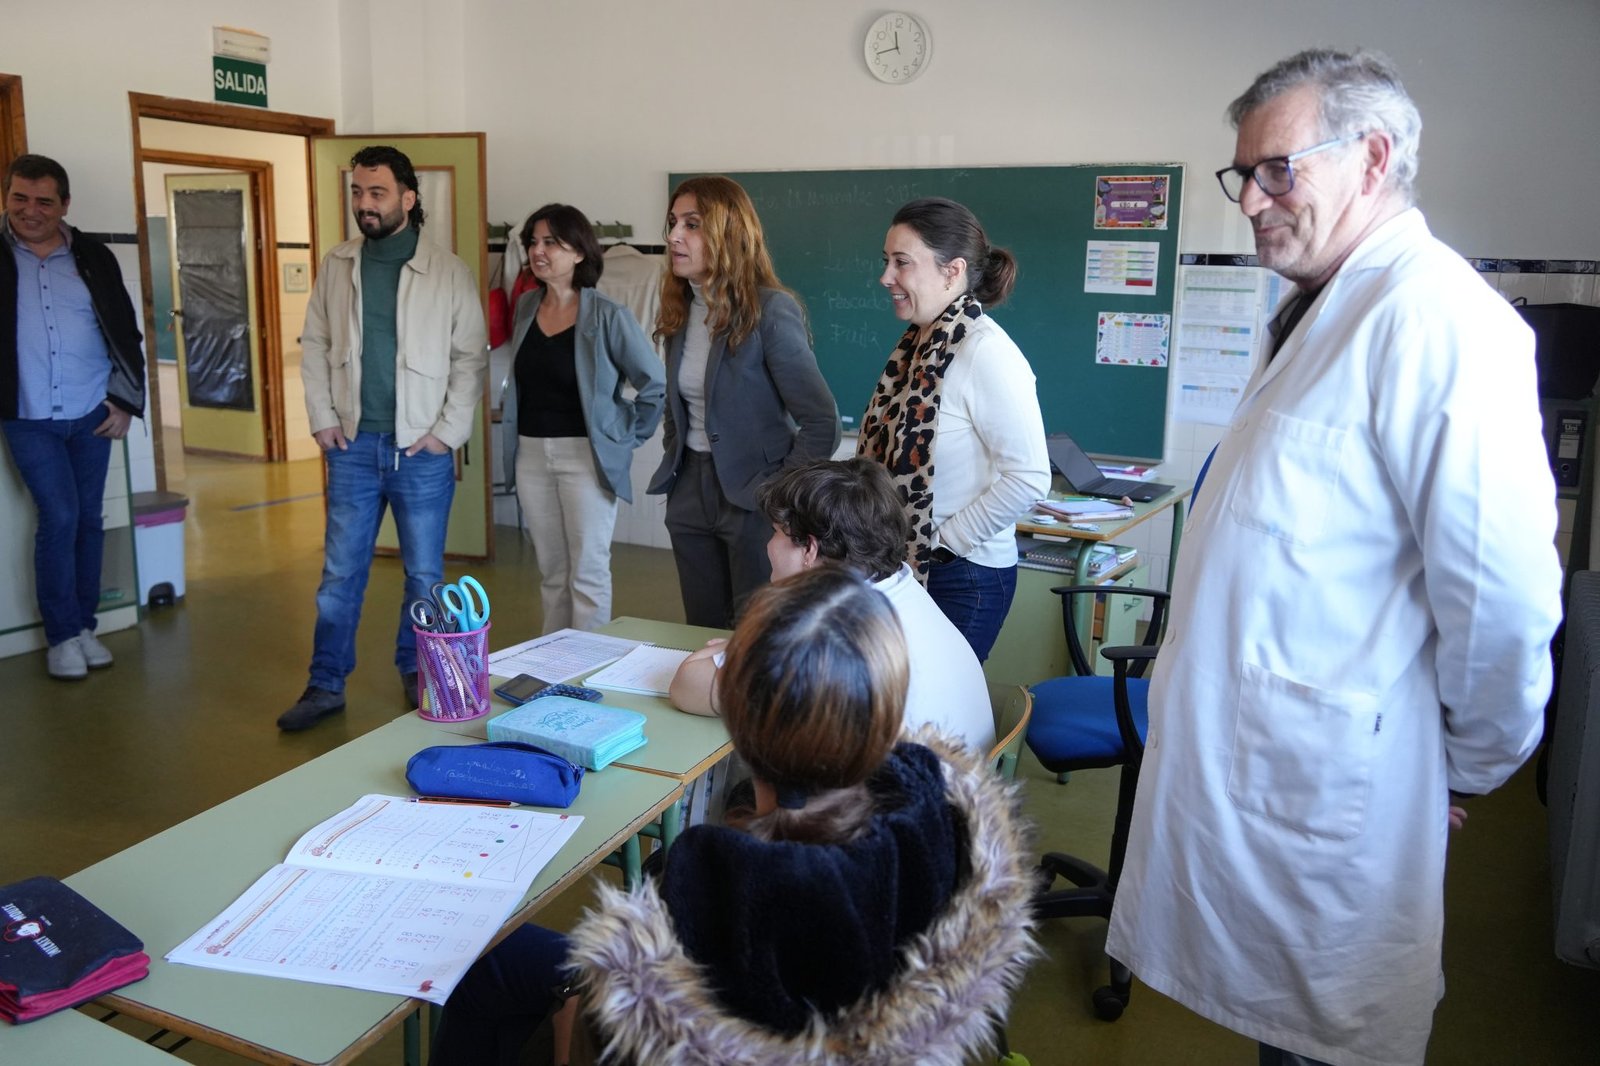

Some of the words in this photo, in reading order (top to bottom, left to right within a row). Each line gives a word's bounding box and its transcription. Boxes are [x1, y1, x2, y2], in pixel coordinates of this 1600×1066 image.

[895, 17, 904, 29] 12
[913, 31, 922, 42] 2
[872, 42, 879, 52] 9
[915, 44, 922, 55] 3
[911, 57, 919, 67] 4
[882, 64, 889, 74] 7
[891, 68, 899, 79] 6
[903, 65, 910, 76] 5
[214, 68, 266, 95] SALIDA
[410, 933, 427, 944] 22
[374, 957, 391, 969] 37
